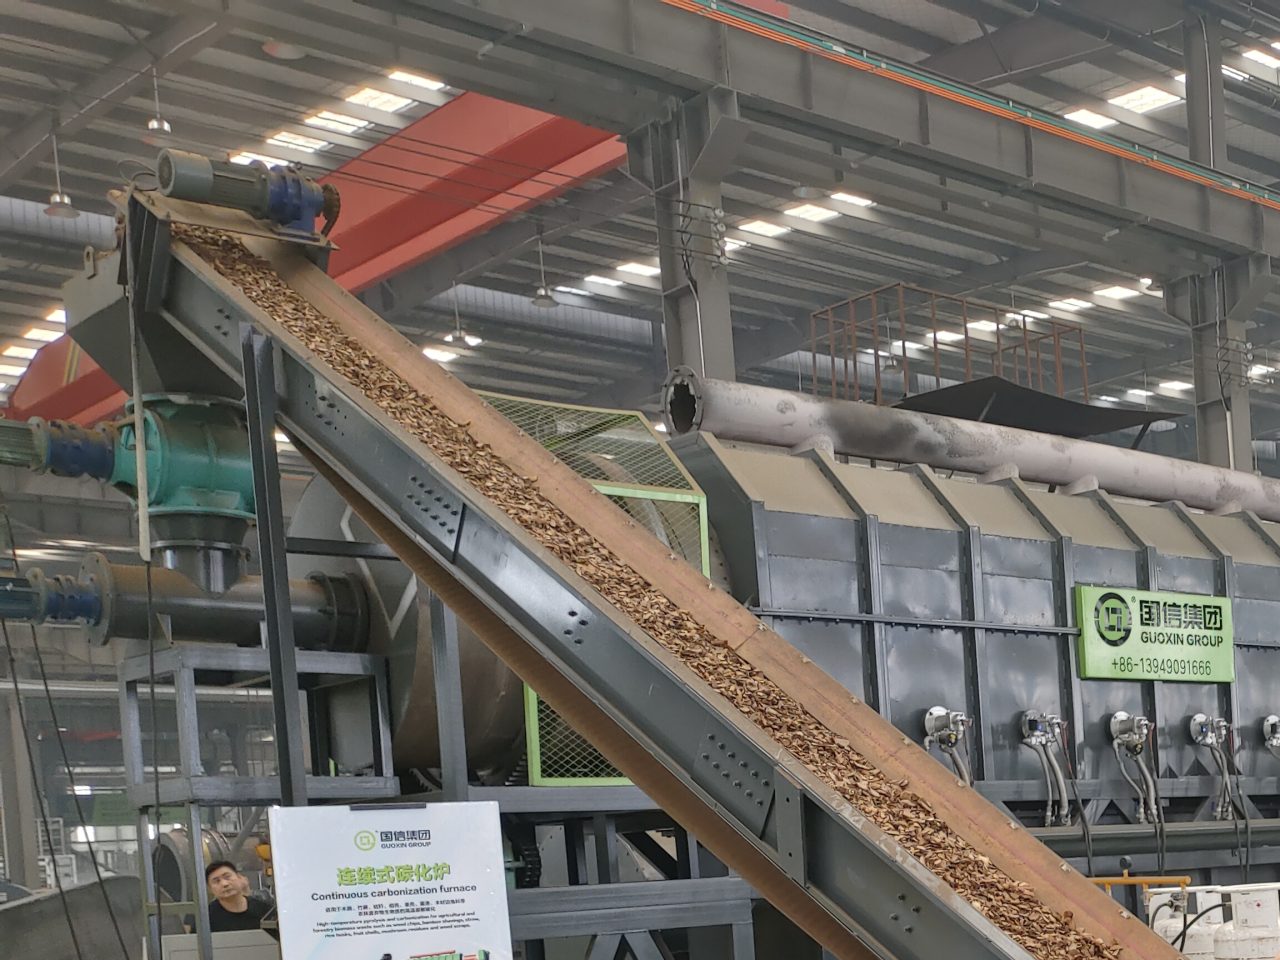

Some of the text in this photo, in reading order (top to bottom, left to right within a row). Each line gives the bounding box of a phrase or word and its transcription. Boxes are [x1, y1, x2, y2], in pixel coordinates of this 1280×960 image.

[1139, 599, 1223, 631] 国信集团
[1140, 631, 1224, 648] GUOXIN GROUP
[1111, 656, 1212, 676] +86-13949091666
[380, 829, 431, 842] 国信集团
[336, 862, 451, 887] 连续式碳化炉
[311, 890, 369, 901] Continuous
[371, 886, 438, 898] carbonization
